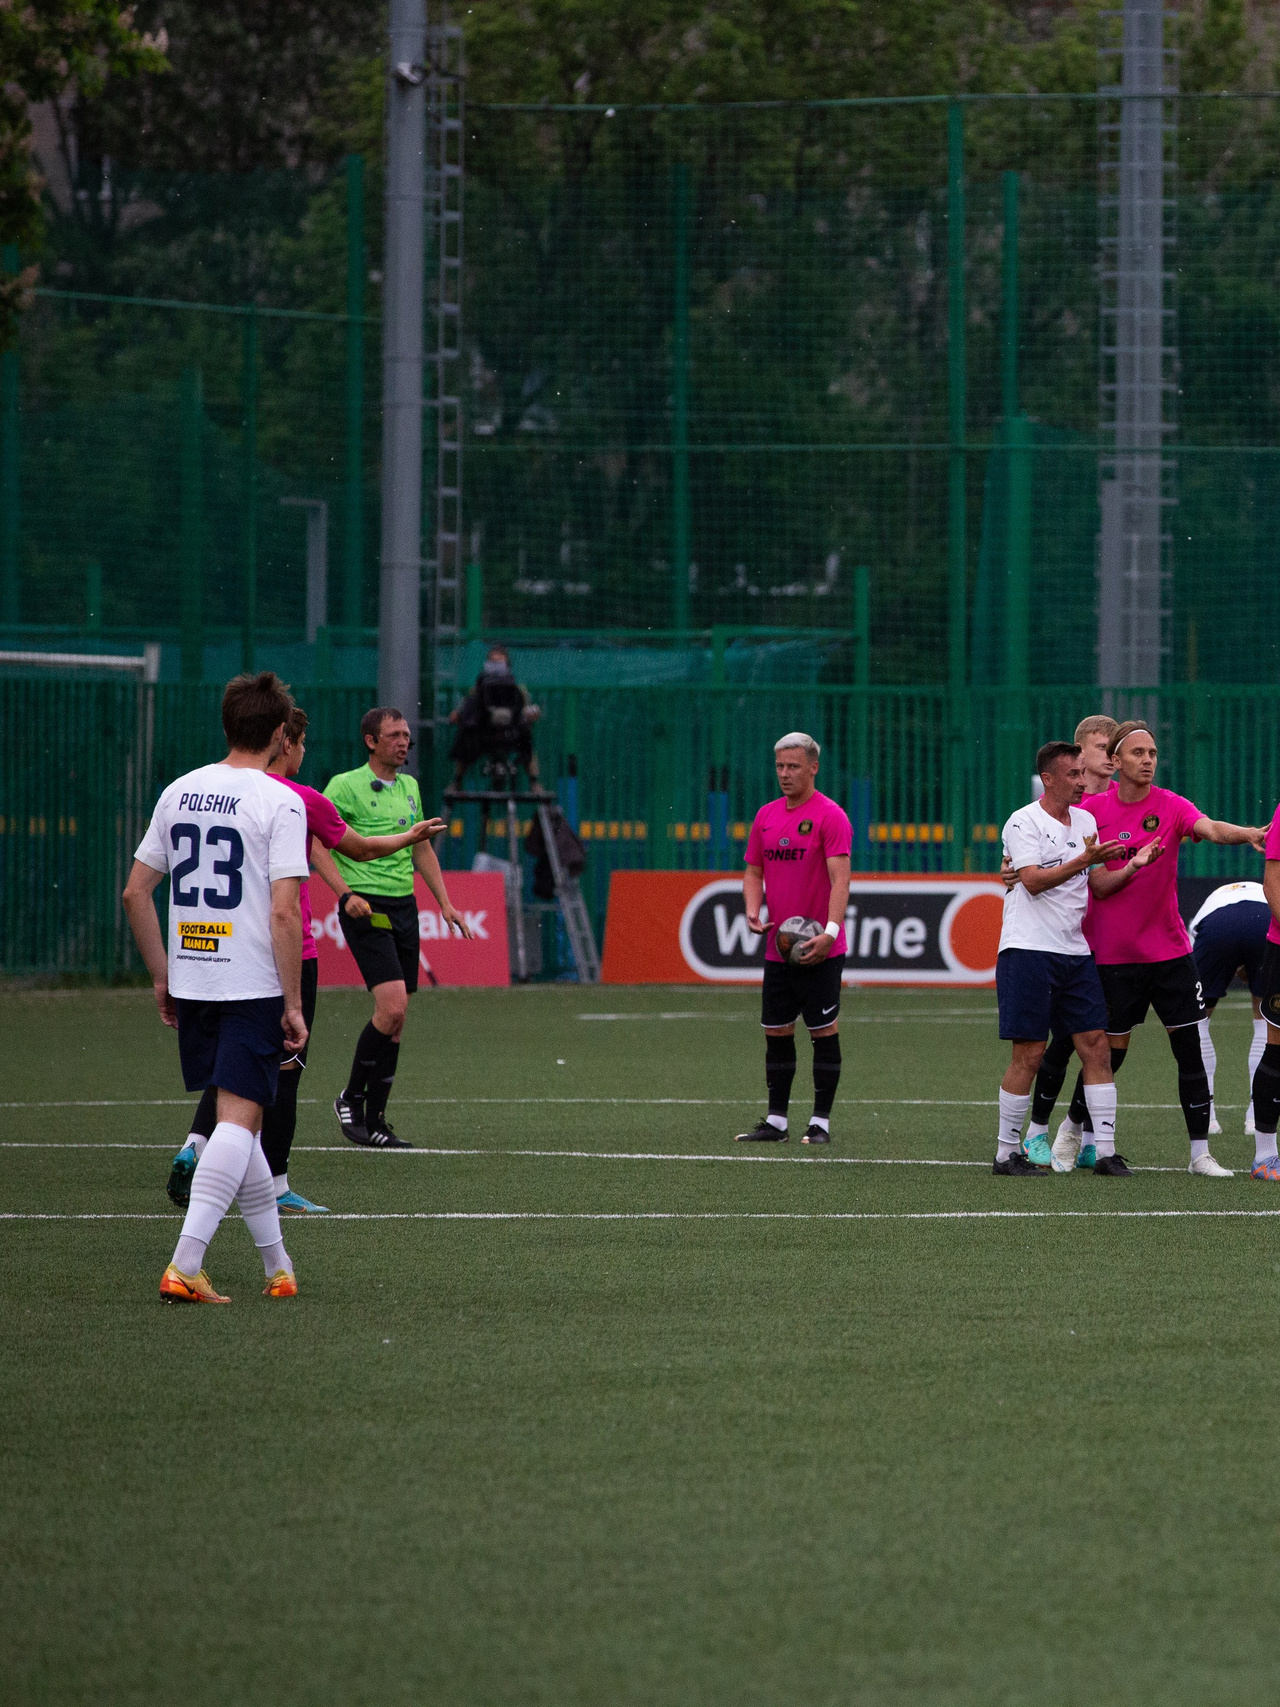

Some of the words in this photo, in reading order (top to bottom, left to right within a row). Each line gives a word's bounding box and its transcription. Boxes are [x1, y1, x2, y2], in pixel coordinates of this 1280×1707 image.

[178, 793, 241, 815] POLSHIK
[763, 848, 807, 861] FONBET
[170, 822, 245, 910] 23
[181, 924, 227, 935] FOOTBALL
[418, 910, 490, 940] анк
[714, 904, 927, 958] Wine
[183, 937, 216, 951] MANIA
